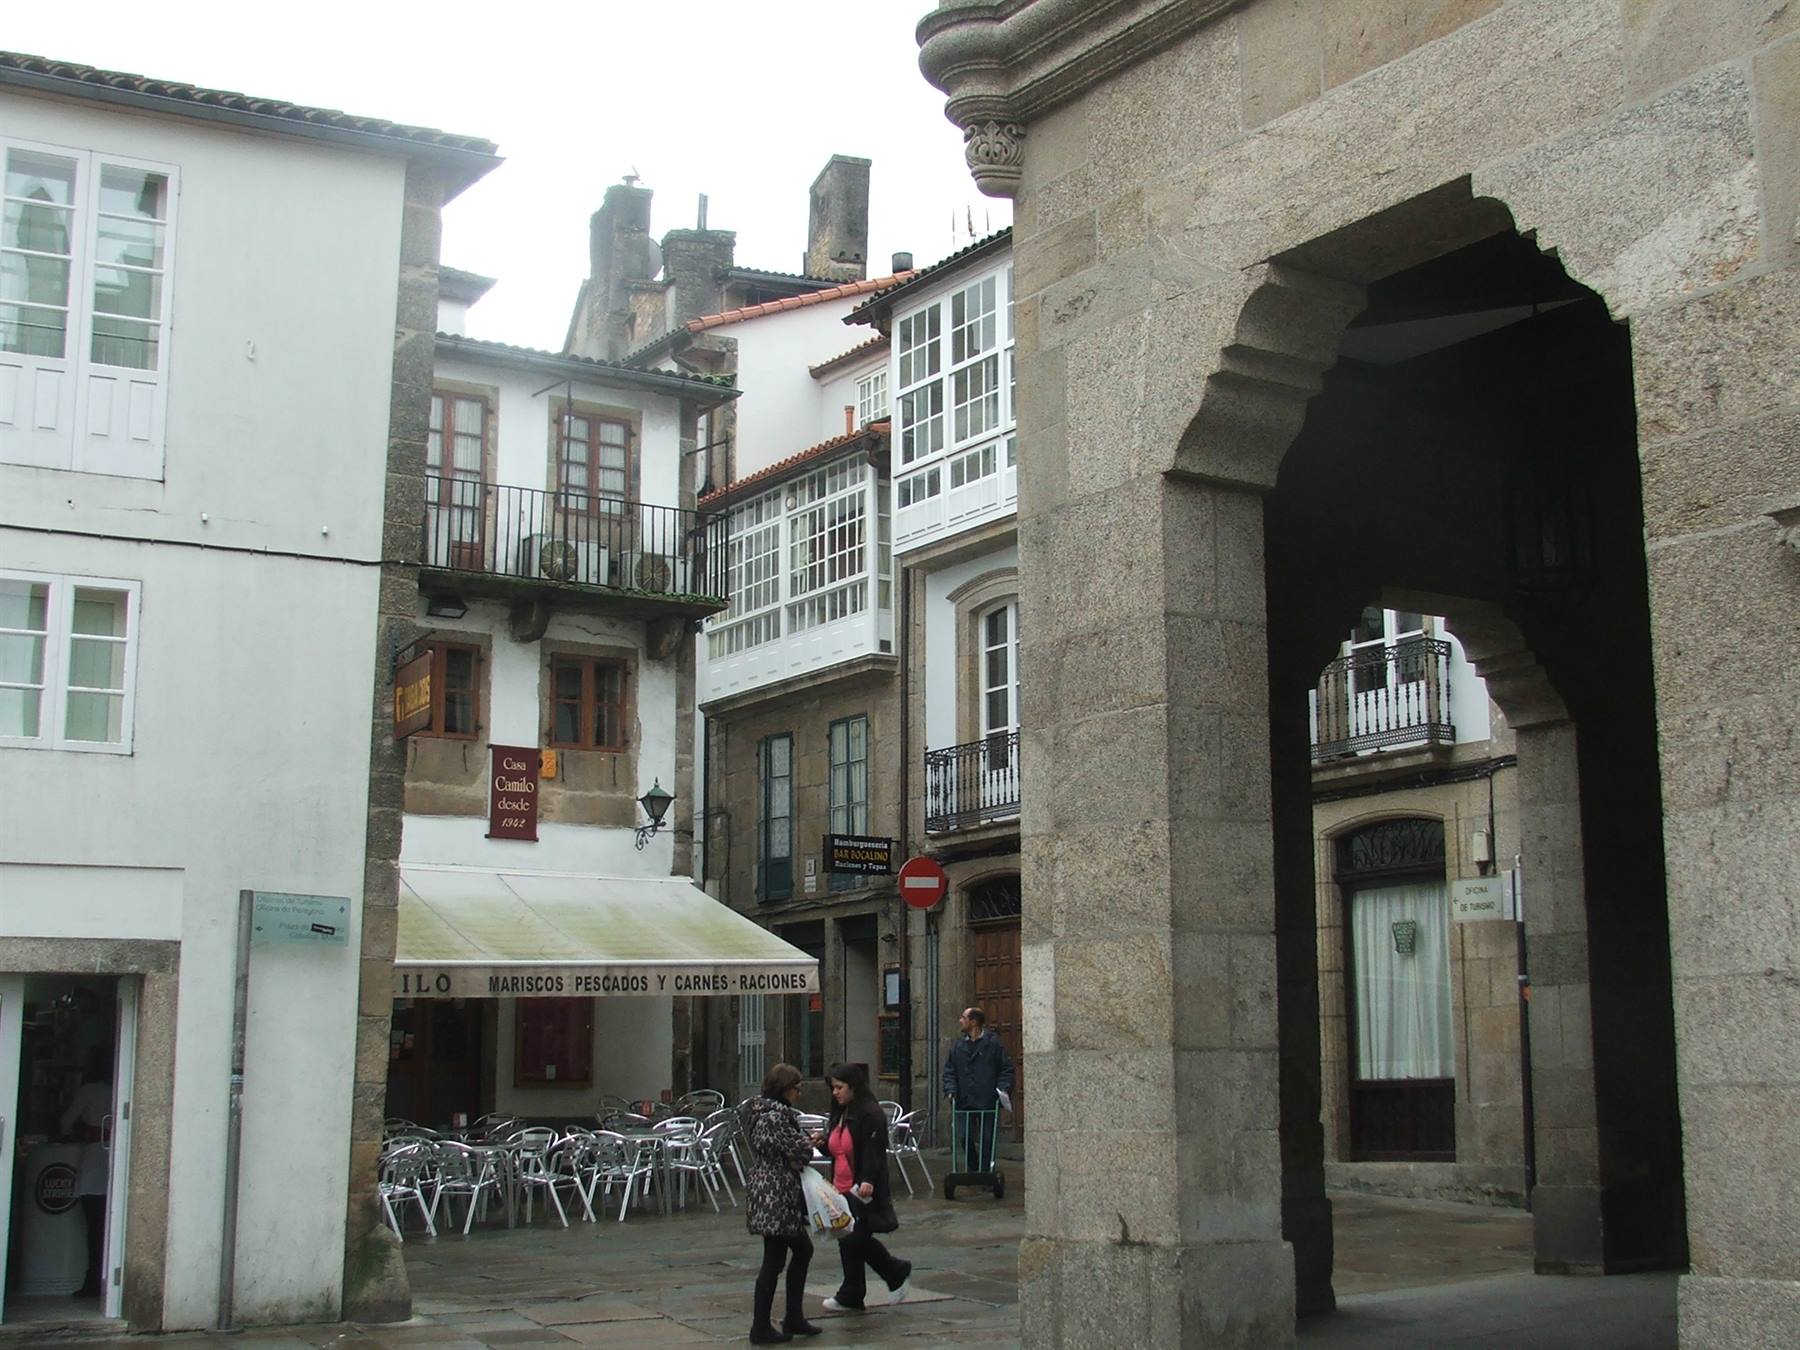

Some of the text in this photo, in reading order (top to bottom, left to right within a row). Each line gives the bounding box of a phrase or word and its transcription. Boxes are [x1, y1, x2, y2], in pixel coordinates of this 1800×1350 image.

[503, 757, 527, 771] Casa
[495, 775, 535, 793] Camilo
[497, 796, 530, 811] desde
[501, 817, 526, 828] 1942
[392, 973, 807, 994] ILO MARISCOS PESCADOS Y CARNES RACIONES
[44, 1177, 73, 1187] LUCKY
